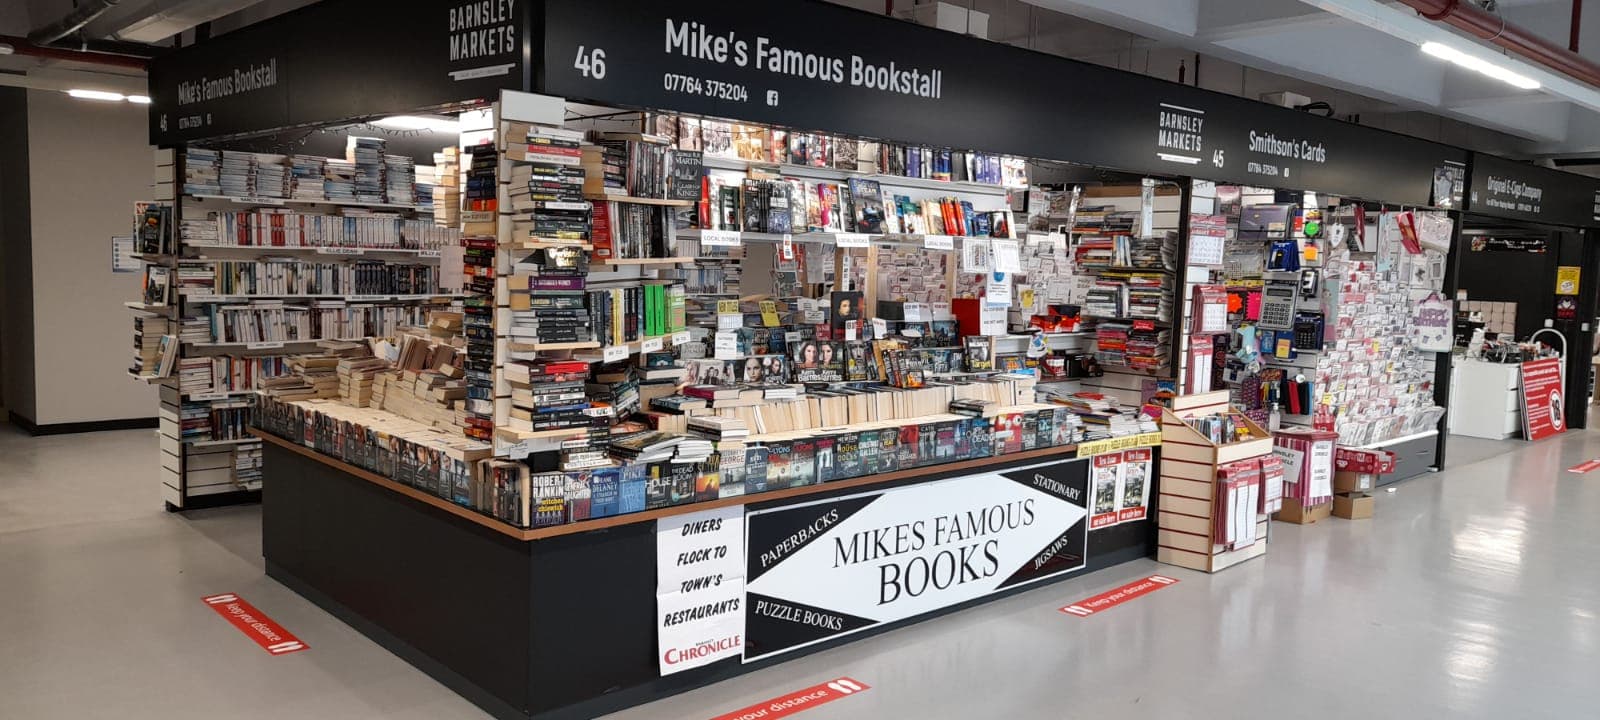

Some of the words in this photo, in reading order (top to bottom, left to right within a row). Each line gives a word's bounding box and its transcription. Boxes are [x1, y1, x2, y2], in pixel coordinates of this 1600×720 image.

[450, 0, 514, 31] BARNSLEY
[450, 25, 514, 61] MARKETS
[574, 46, 606, 80] 46
[665, 19, 748, 68] Mike's
[756, 37, 844, 83] Famous
[850, 55, 942, 99] Bookstall
[178, 80, 201, 105] Mike's
[202, 77, 233, 100] Famous
[234, 58, 277, 93] Bookstall
[664, 73, 702, 94] 07764
[705, 82, 748, 103] 375204
[160, 114, 168, 132] 46
[1160, 111, 1203, 133] BARNSLEY
[1158, 129, 1201, 152] MARKETS
[1249, 130, 1299, 160] Smithson's
[1301, 140, 1326, 163] Cards
[676, 157, 702, 165] MARTIN
[1212, 150, 1224, 168] 45
[677, 189, 698, 197] KINGS
[1487, 175, 1507, 196] Original
[1522, 182, 1542, 202] Company
[720, 455, 744, 464] GEORGE
[533, 475, 564, 487] ROBERT
[533, 485, 564, 498] RANKIN
[645, 477, 671, 488] HOUSE
[1032, 471, 1080, 500] STATIONARY
[681, 517, 723, 537] DINERS
[759, 508, 841, 567] PAPERBACKS
[832, 523, 926, 569] MIKES
[932, 497, 1036, 547] FAMOUS
[677, 548, 711, 567] FLOCK
[713, 545, 727, 560] TO
[1033, 535, 1069, 571] JIGSAWS
[680, 573, 723, 594] TOWN'S
[876, 538, 1000, 606] BOOKS
[663, 598, 740, 628] RESTAURANTS
[755, 600, 801, 622] PUZZLE
[803, 609, 844, 631] BOOKS
[251, 621, 281, 641] distance
[770, 689, 828, 712] distance
